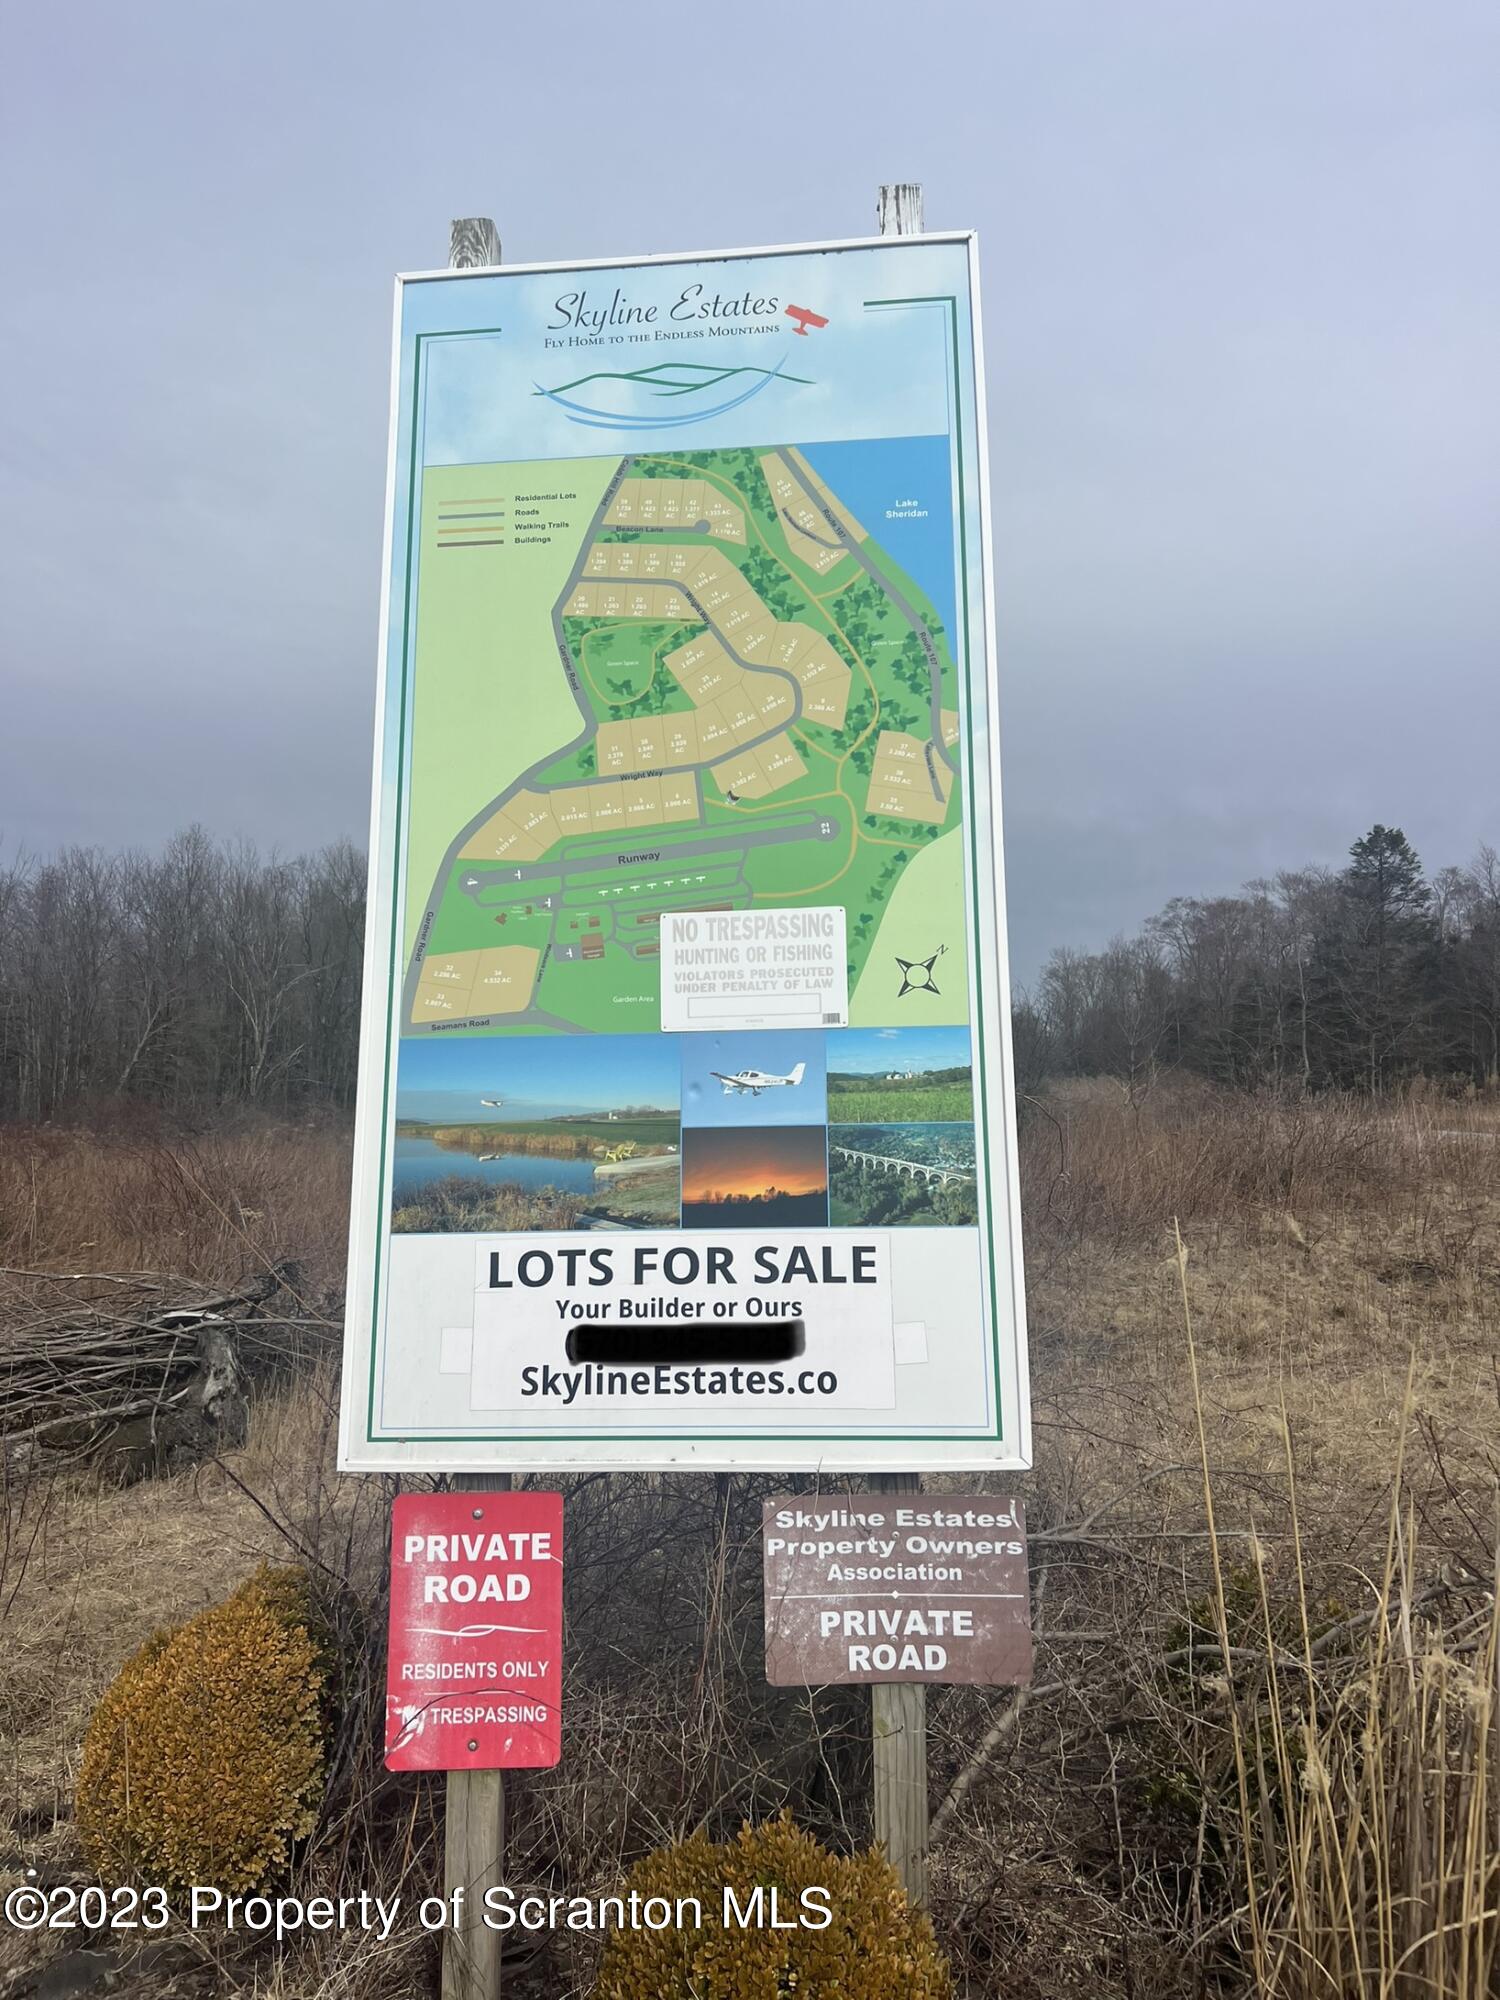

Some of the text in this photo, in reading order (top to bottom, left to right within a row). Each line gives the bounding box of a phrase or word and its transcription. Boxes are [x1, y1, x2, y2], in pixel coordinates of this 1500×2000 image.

[547, 284, 779, 336] Skyline Estates
[544, 324, 780, 349] FLY HOME TO THE ENDLESS MOUNTAINS
[515, 492, 577, 502] Residential Lots
[895, 499, 918, 507] Lake
[822, 508, 847, 539] Route 107
[885, 509, 929, 519] Sheridan
[515, 521, 570, 532] Walking Trails
[514, 536, 552, 545] Buildings
[919, 631, 933, 655] Route
[559, 644, 579, 691] Gardner Road
[619, 769, 664, 782] Wright Way
[618, 850, 660, 865] Runway
[415, 911, 434, 962] Gardner Road
[672, 913, 834, 943] NO TRESPASSING
[674, 943, 833, 966] HUNTING OR FISHING
[936, 943, 949, 955] N
[674, 967, 834, 982] VIOLATORS PROSECUTED
[675, 978, 833, 994] UNDER PENALTY OF LAW
[613, 995, 655, 1003] Garden Area
[431, 1019, 490, 1031] Seamans Road
[488, 1245, 878, 1289] LOTS FOR SALE
[555, 1296, 804, 1319] Your Builder or Ours
[520, 1363, 839, 1405] SkylineEstates.co
[775, 1508, 1013, 1532] Skyline Estates
[404, 1532, 552, 1563] PRIVATE
[767, 1536, 1025, 1558] Property Owners
[827, 1563, 963, 1581] Association
[423, 1574, 531, 1603] ROAD
[820, 1610, 975, 1638] PRIVATE
[849, 1644, 948, 1672] ROAD
[401, 1660, 550, 1681] RESIDENTS ONLY
[431, 1704, 547, 1725] TRESPASSING
